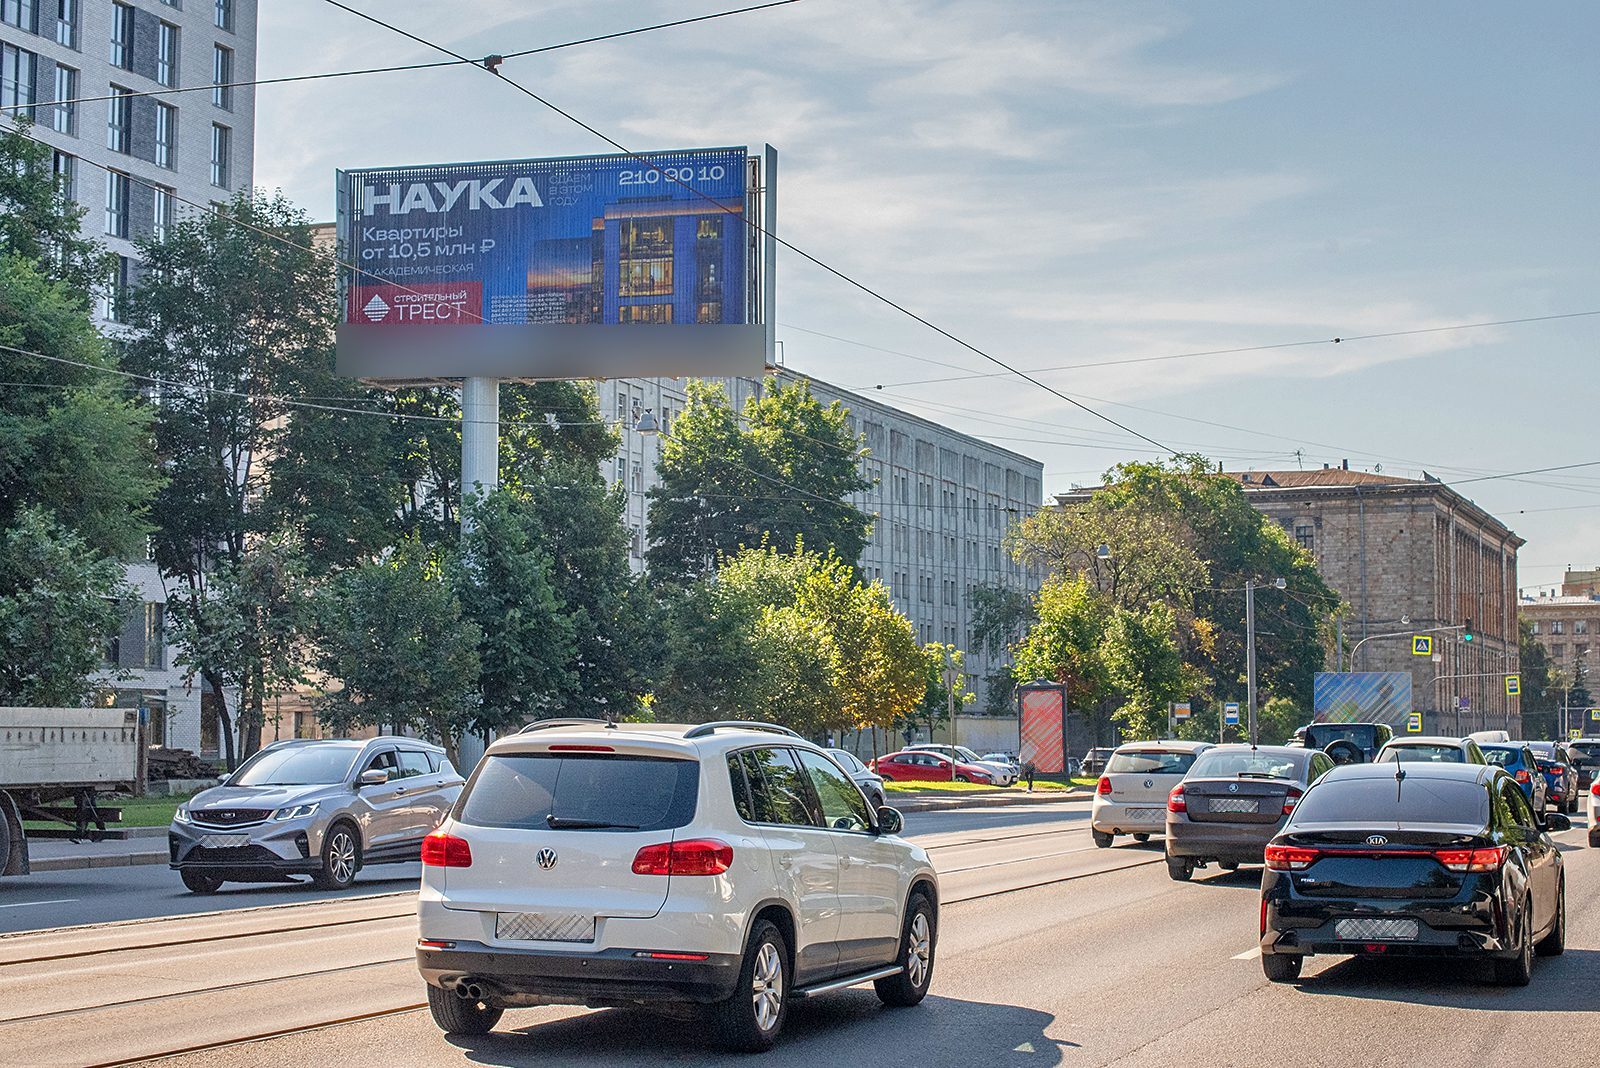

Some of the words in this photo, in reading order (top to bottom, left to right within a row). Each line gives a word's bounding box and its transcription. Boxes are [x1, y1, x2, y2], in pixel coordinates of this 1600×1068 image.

[619, 169, 660, 185] 210
[664, 167, 693, 183] 90
[698, 165, 725, 181] 10
[363, 177, 544, 216] НАУКА
[550, 186, 557, 195] В
[560, 184, 593, 195] ЭТОМ
[550, 196, 579, 207] ГОДУ
[362, 225, 463, 244] Квартиры
[362, 247, 385, 260] от
[388, 242, 431, 261] 10,5
[435, 243, 475, 256] млн
[374, 262, 474, 277] АКАДЕМИЧЕСКАЯ
[394, 290, 467, 303] СТРОИТЕЛЬНЫЙ
[394, 301, 467, 321] ТРЕСТ
